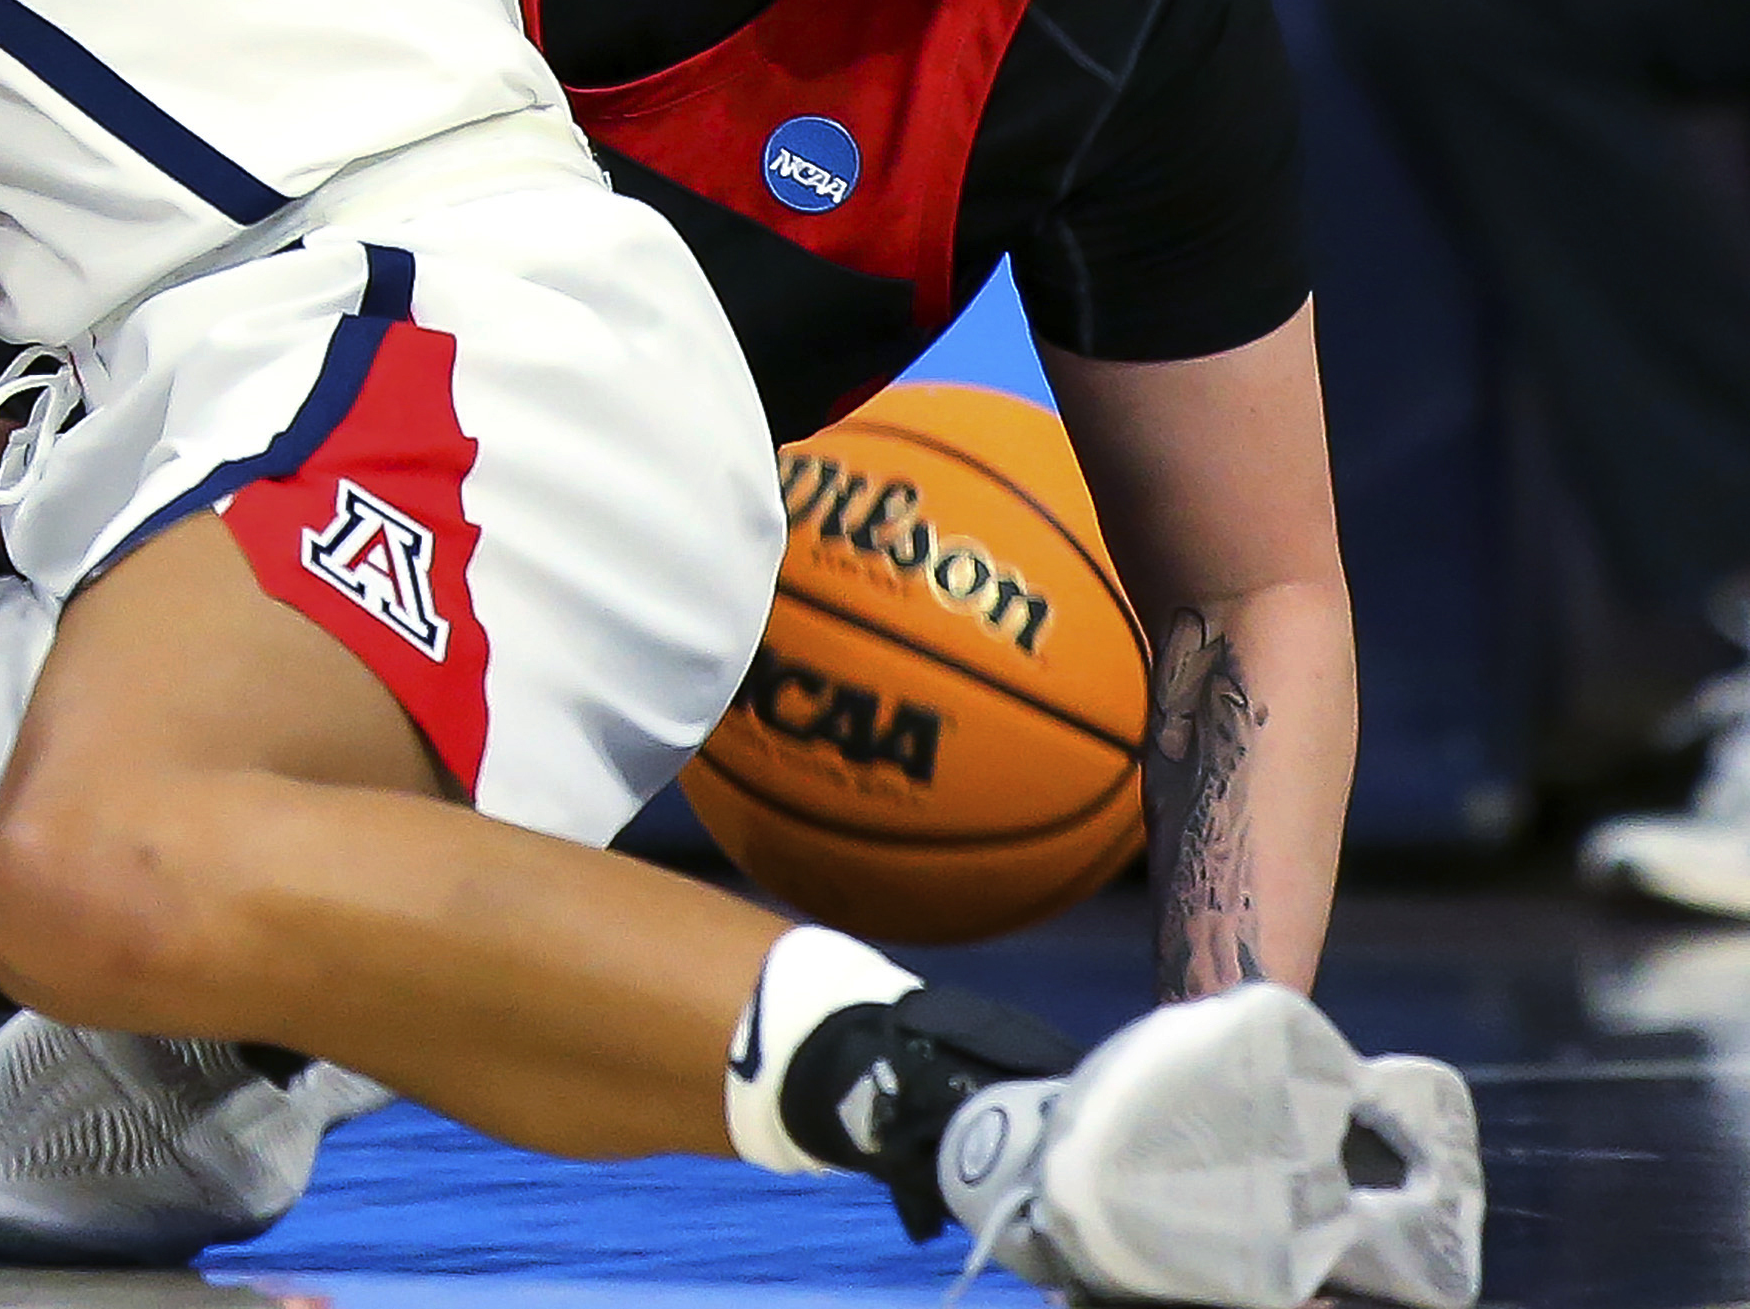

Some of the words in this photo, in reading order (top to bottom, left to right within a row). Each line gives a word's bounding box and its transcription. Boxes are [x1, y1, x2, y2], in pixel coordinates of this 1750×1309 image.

[769, 147, 848, 204] NCAA
[301, 477, 450, 664] A
[734, 644, 941, 782] CAA
